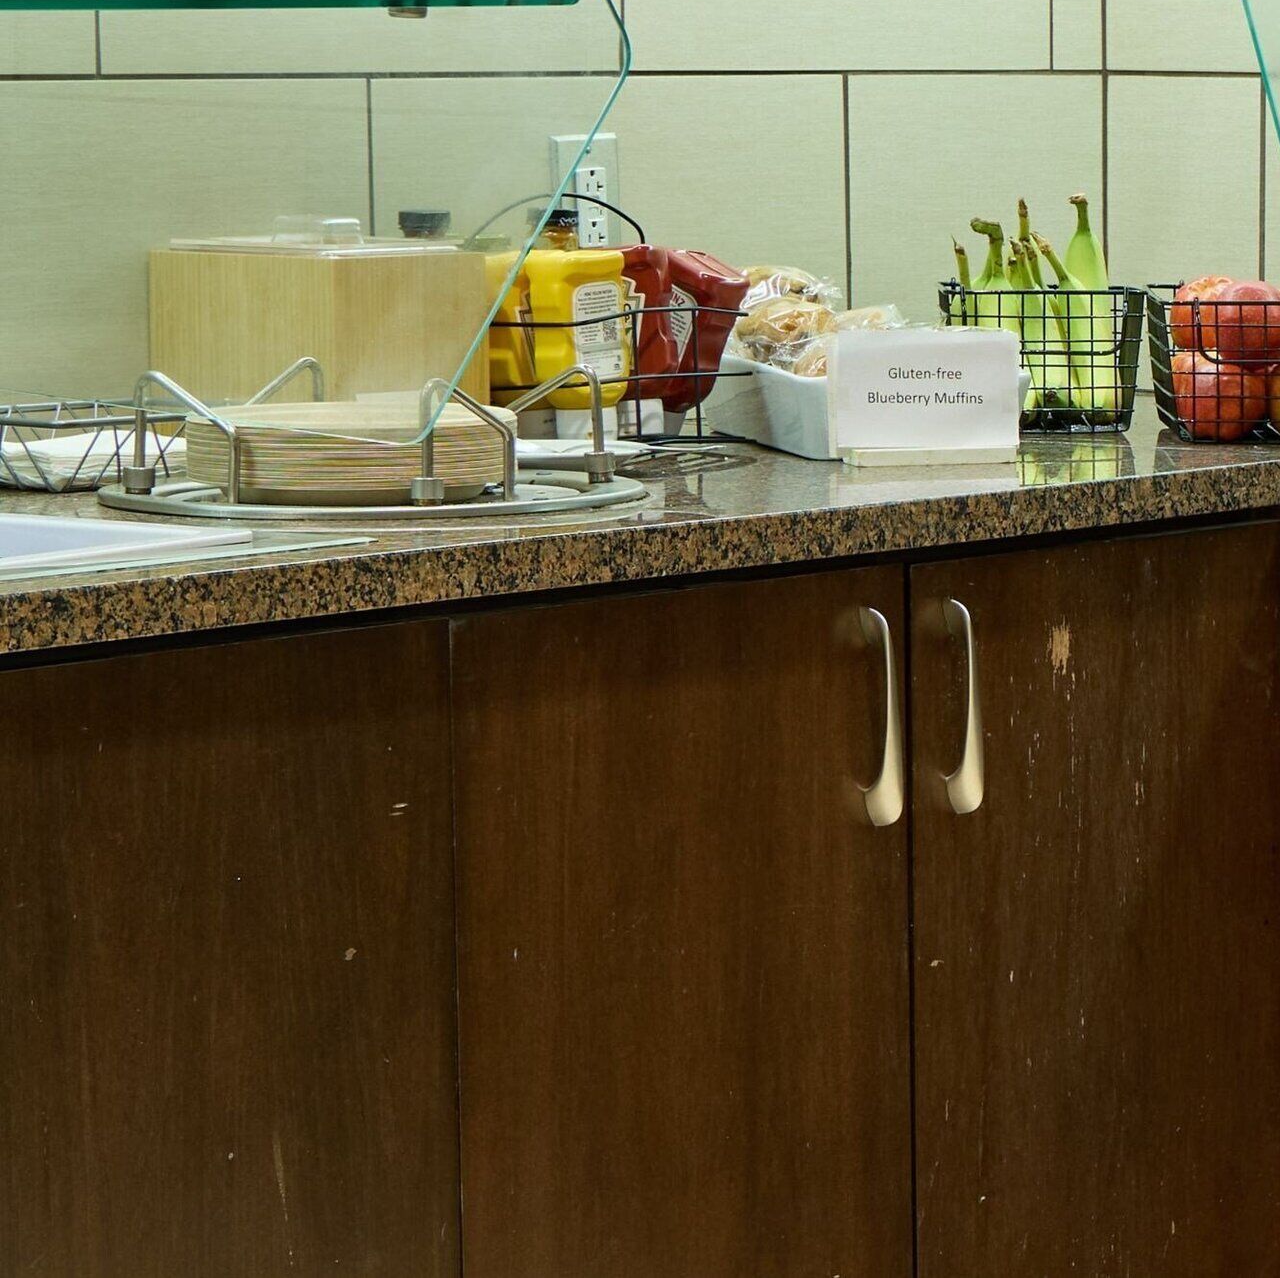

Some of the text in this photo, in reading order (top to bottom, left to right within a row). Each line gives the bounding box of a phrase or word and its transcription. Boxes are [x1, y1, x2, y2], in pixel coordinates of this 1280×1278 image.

[888, 366, 963, 380] Gluten-free
[867, 391, 984, 407] Blueberry Muffins
